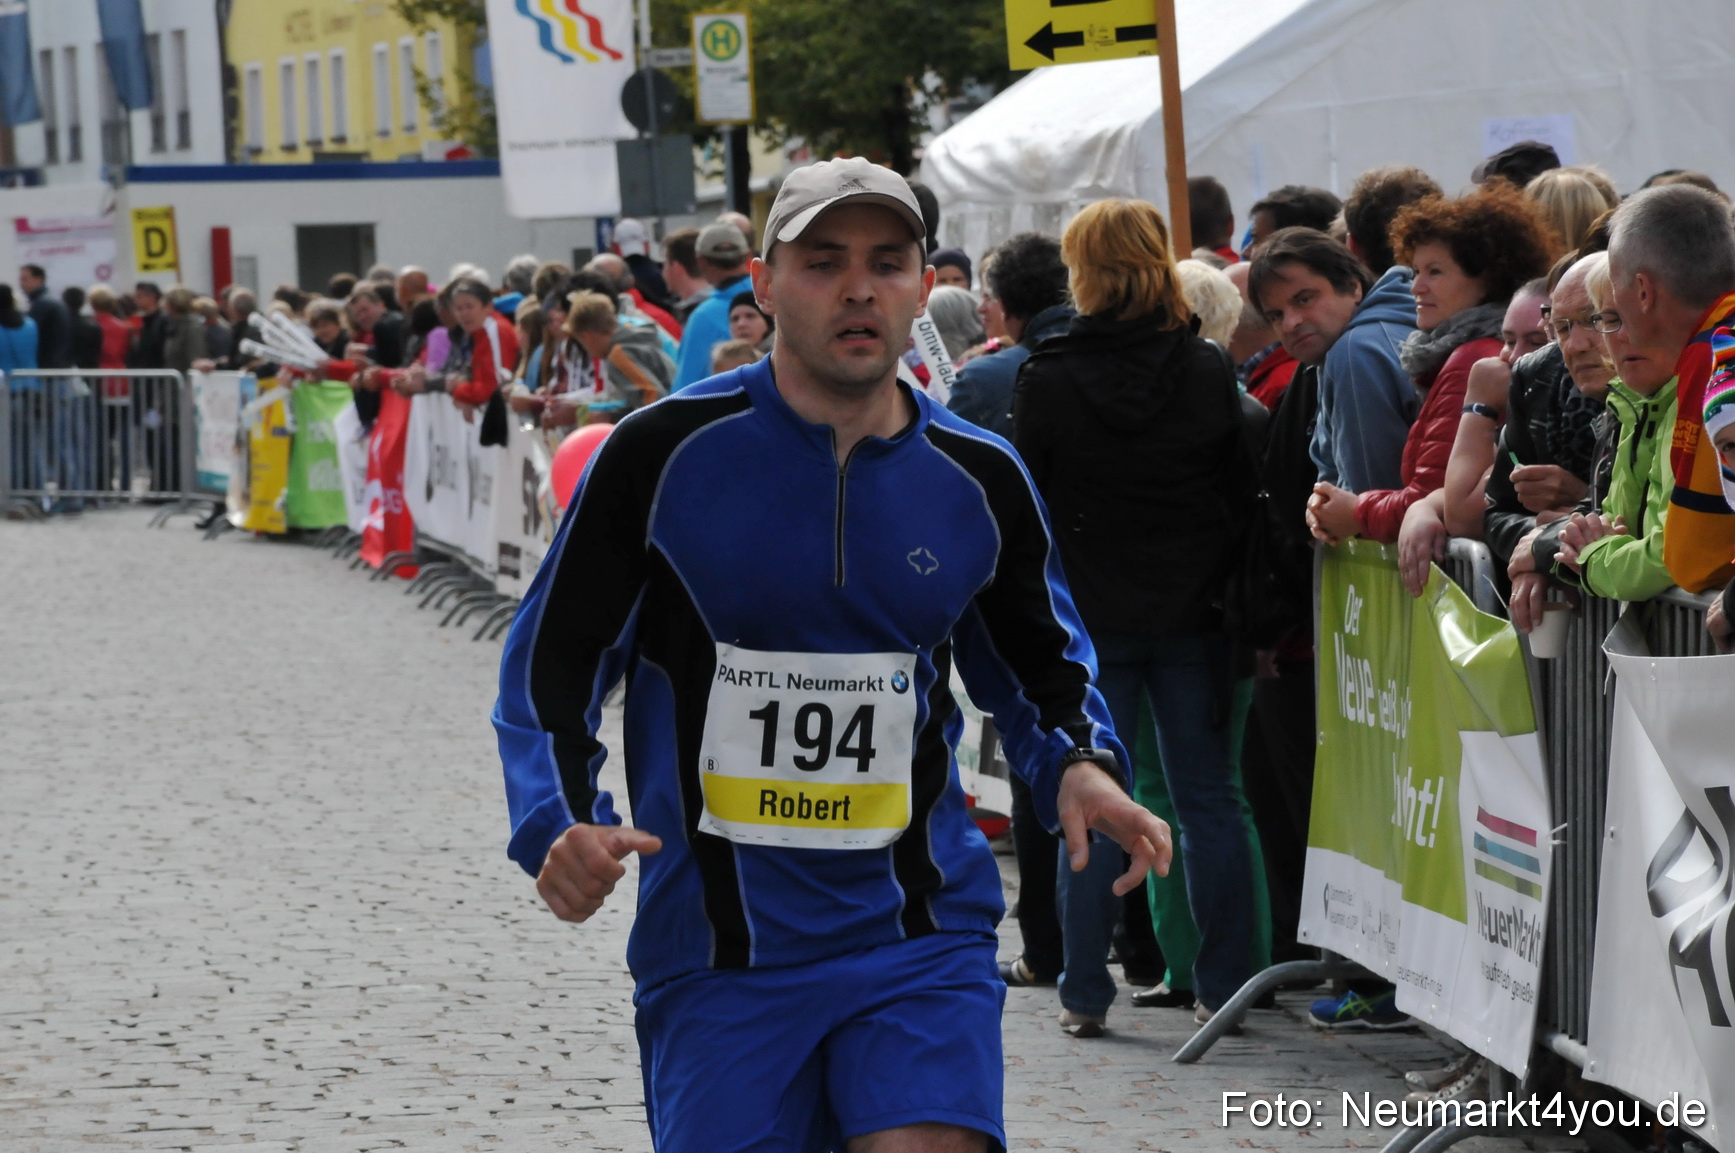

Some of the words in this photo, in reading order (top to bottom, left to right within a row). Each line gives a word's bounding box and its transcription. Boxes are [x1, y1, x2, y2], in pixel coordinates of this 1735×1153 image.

[144, 227, 168, 258] D
[917, 320, 957, 390] bmw-lau
[1344, 584, 1363, 636] Der
[717, 663, 781, 689] PARTL
[786, 673, 885, 692] Neumarkt
[1334, 631, 1376, 728] Neue
[749, 700, 877, 773] 194
[706, 758, 715, 771] B
[759, 788, 851, 821] Robert
[1474, 888, 1542, 968] NeuerMarkt
